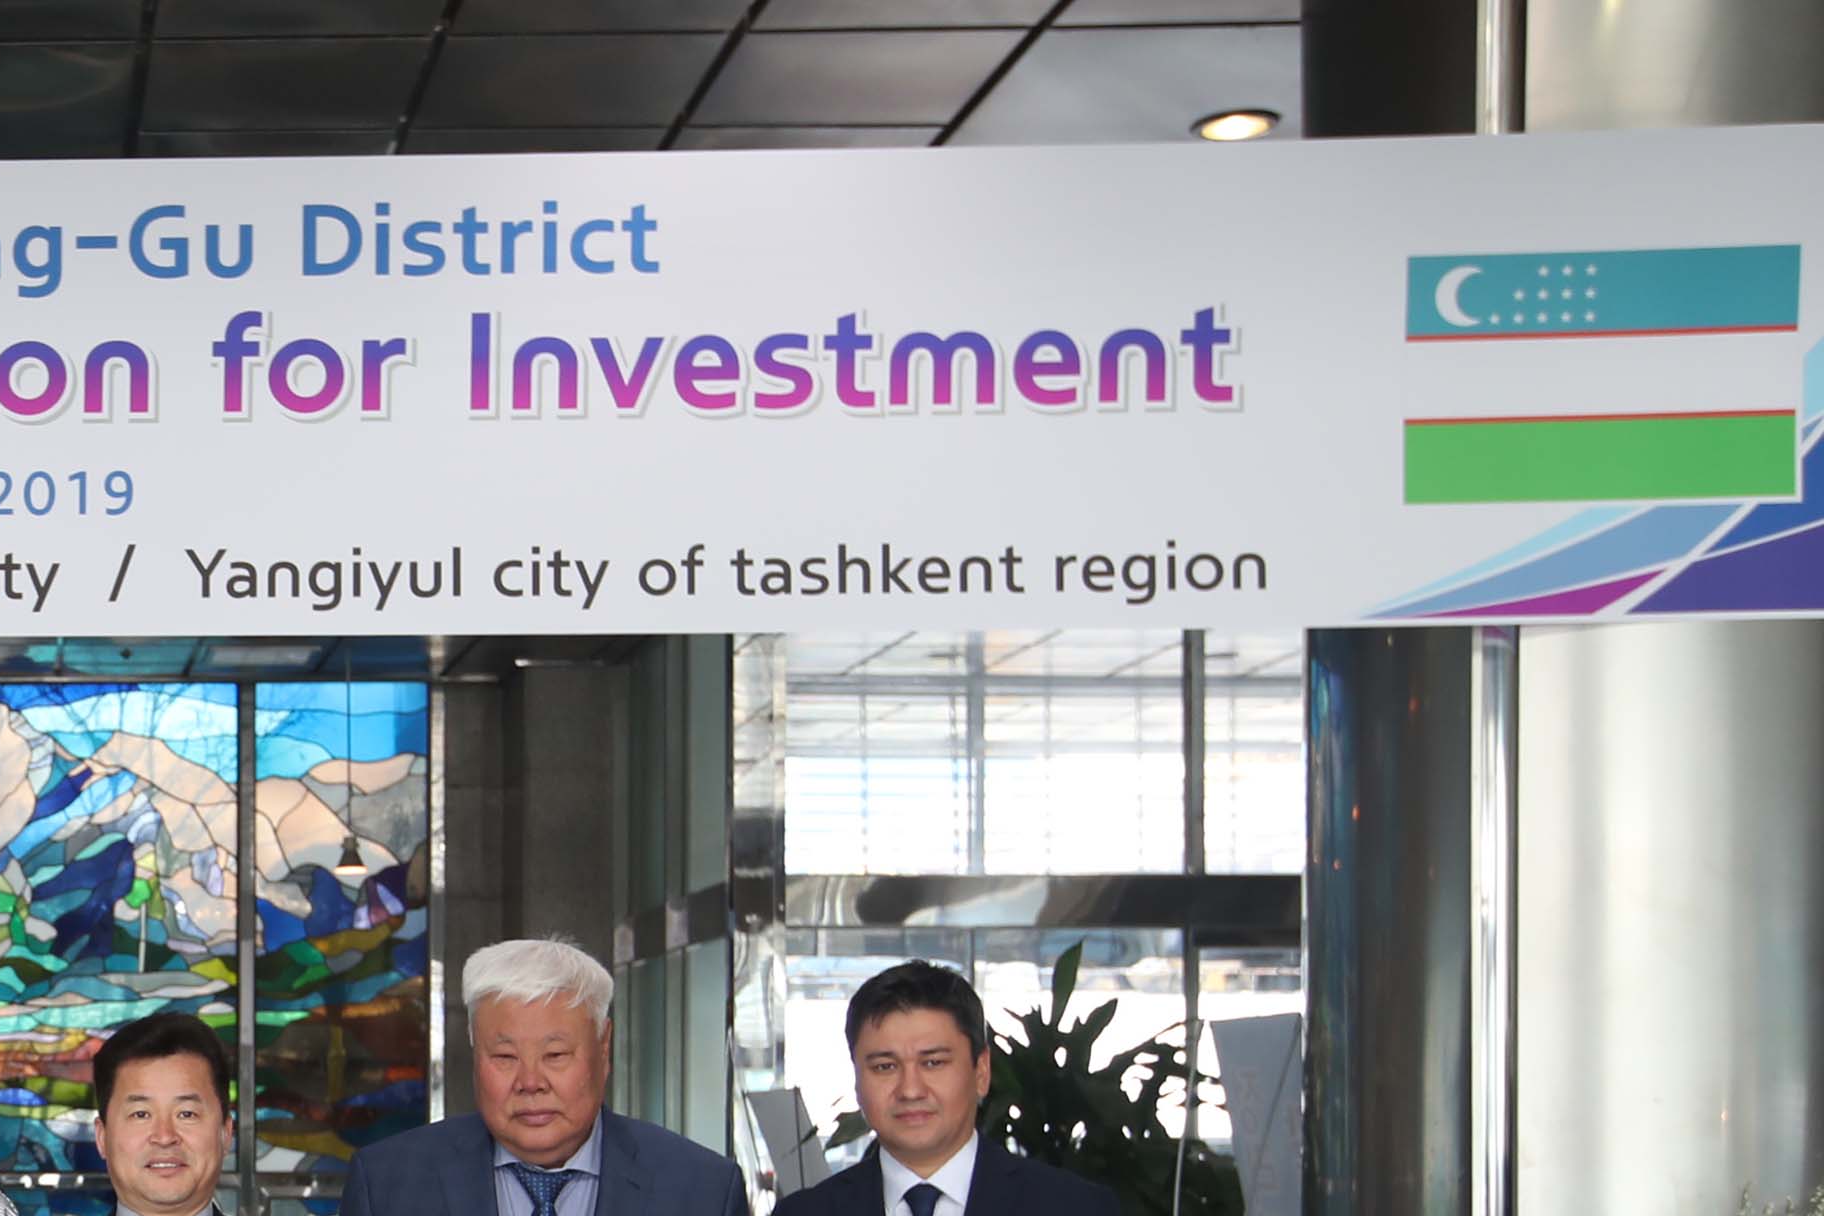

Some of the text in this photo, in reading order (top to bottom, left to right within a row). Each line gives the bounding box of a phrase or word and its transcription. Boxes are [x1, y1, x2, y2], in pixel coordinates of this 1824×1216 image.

[302, 199, 661, 278] District
[211, 310, 409, 417] for
[469, 304, 1238, 413] Investment
[107, 543, 137, 603] /
[184, 545, 463, 613] Yangiyul
[492, 544, 611, 611] city
[637, 542, 706, 598] of
[729, 542, 1027, 598] tashkent
[1053, 541, 1269, 607] region
